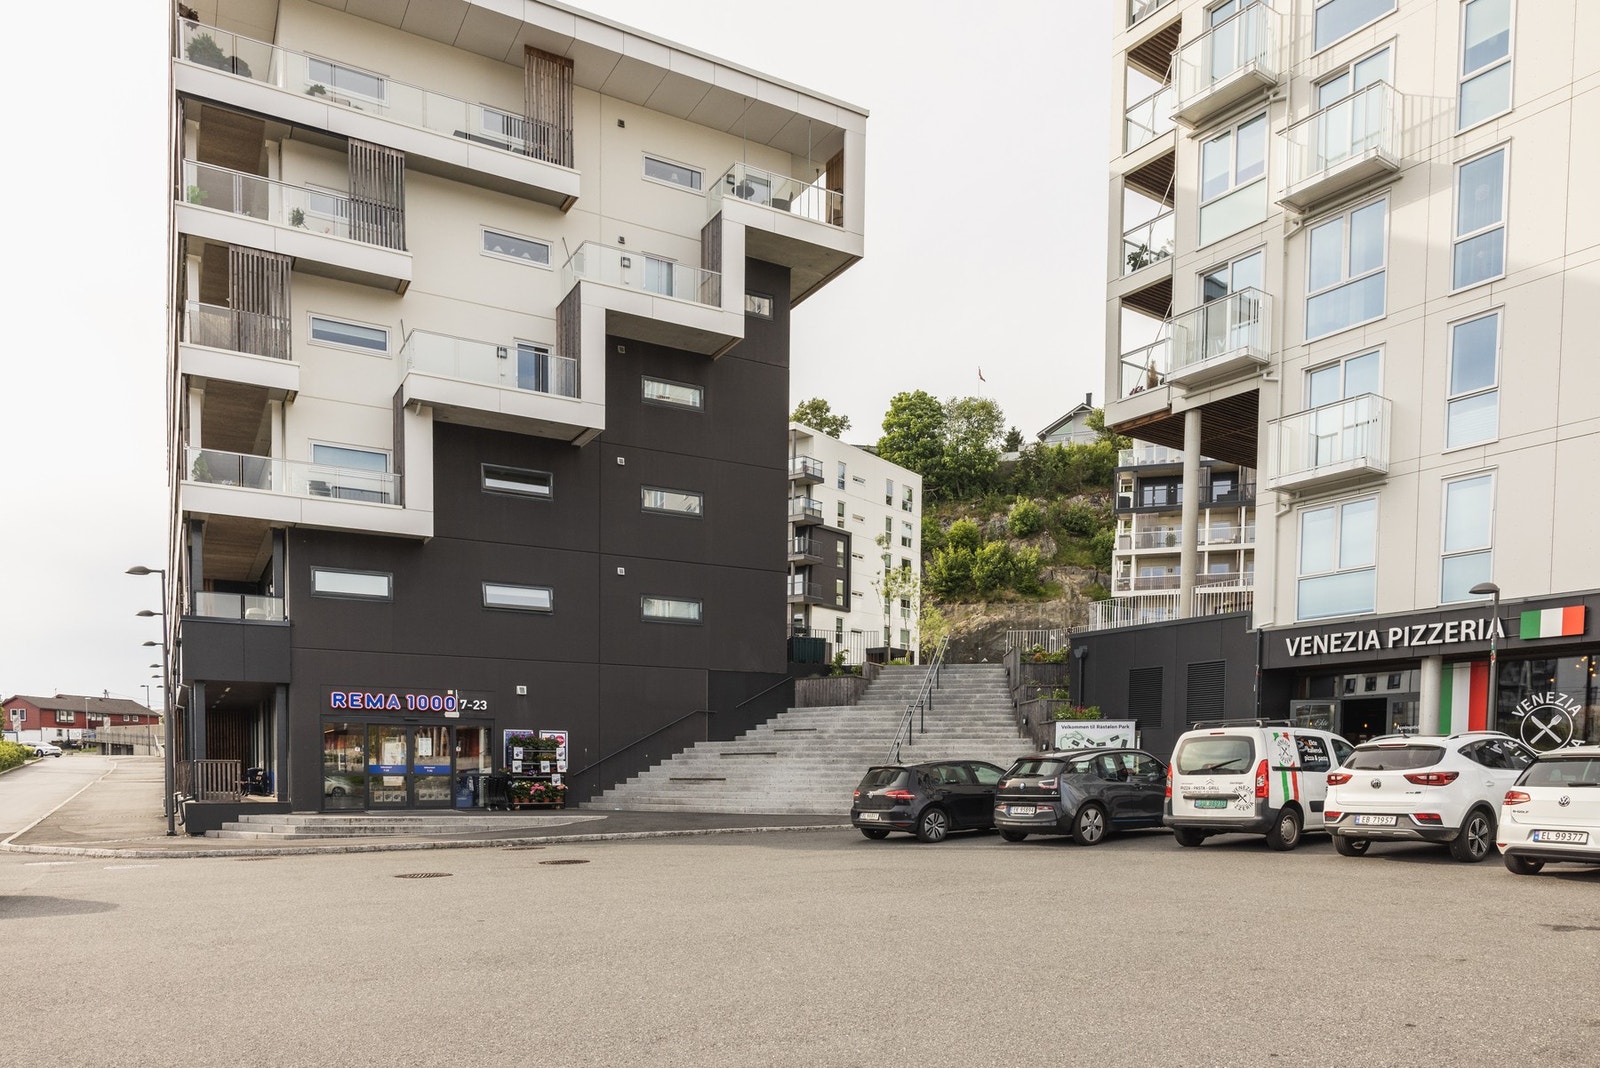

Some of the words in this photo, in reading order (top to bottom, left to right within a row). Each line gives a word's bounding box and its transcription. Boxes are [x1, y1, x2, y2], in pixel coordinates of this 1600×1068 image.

[1285, 629, 1381, 657] VENEZIA
[1388, 617, 1506, 648] PIZZERIA
[330, 691, 401, 710] REMA
[406, 694, 457, 711] 1000
[460, 699, 488, 711] 7-23
[1511, 691, 1582, 718] VENEZIA
[1232, 785, 1254, 795] VENEZIA
[1372, 816, 1394, 824] 71957
[1541, 831, 1551, 840] EL
[1555, 832, 1584, 842] 99377
